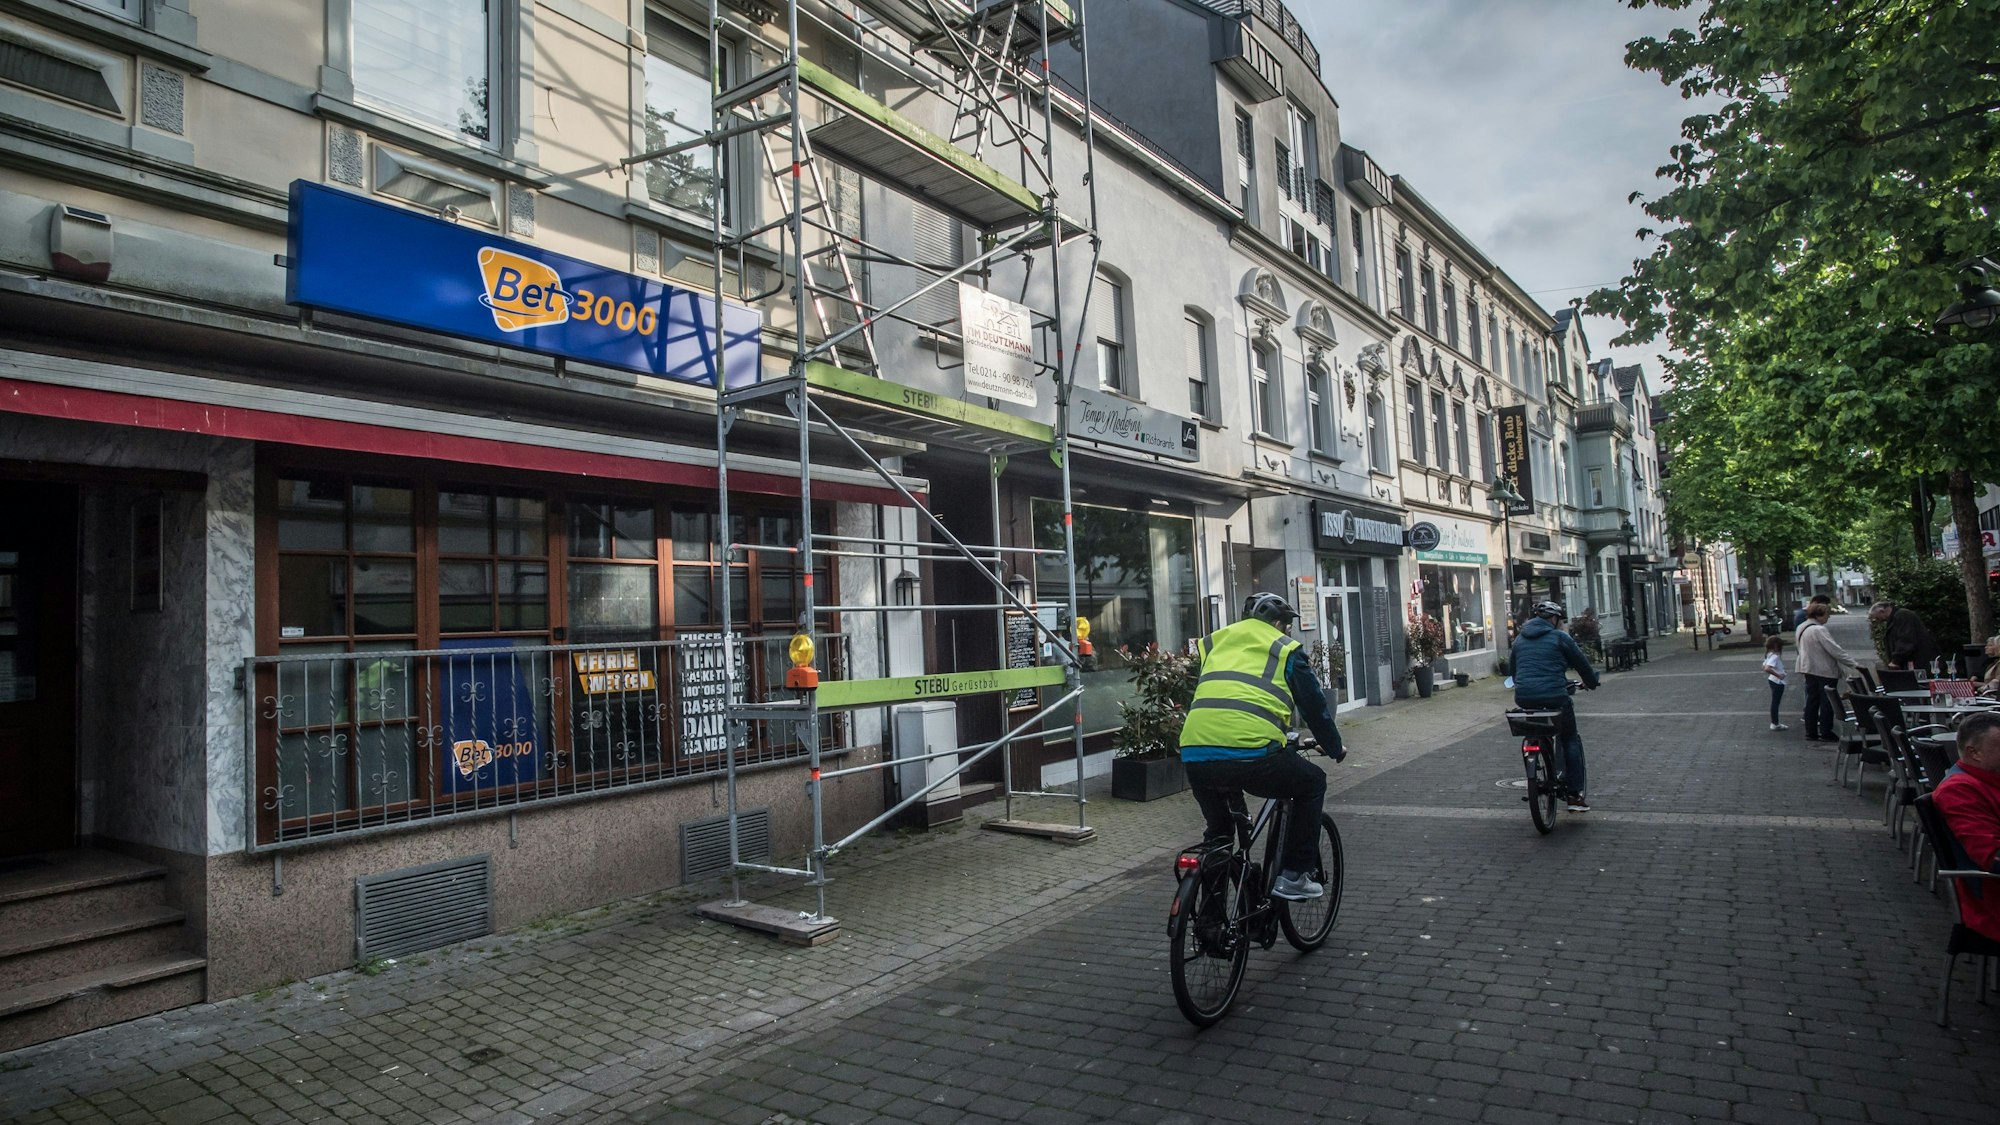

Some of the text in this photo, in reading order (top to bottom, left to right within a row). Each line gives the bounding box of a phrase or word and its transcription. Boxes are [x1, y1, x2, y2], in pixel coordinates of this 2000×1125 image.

[493, 266, 656, 335] Bet 3000
[966, 336, 1032, 362] Dachdeckermeisterbetrieb
[967, 327, 1031, 353] TIM DEUTZMANN
[903, 389, 938, 410] STEBU
[968, 379, 1034, 401] www.deutzmann-dach.de
[1504, 415, 1515, 440] Bub
[1515, 415, 1524, 460] Frischburger
[1145, 433, 1175, 449] Ristorante
[1507, 441, 1518, 472] dicke
[1321, 511, 1344, 538] ISSO
[578, 653, 636, 671] PFERDE
[682, 648, 745, 671] TENNS
[589, 672, 649, 692] WETTEN
[915, 677, 998, 695] STEBU Gerüstbau
[461, 741, 532, 763] Bet 3000
